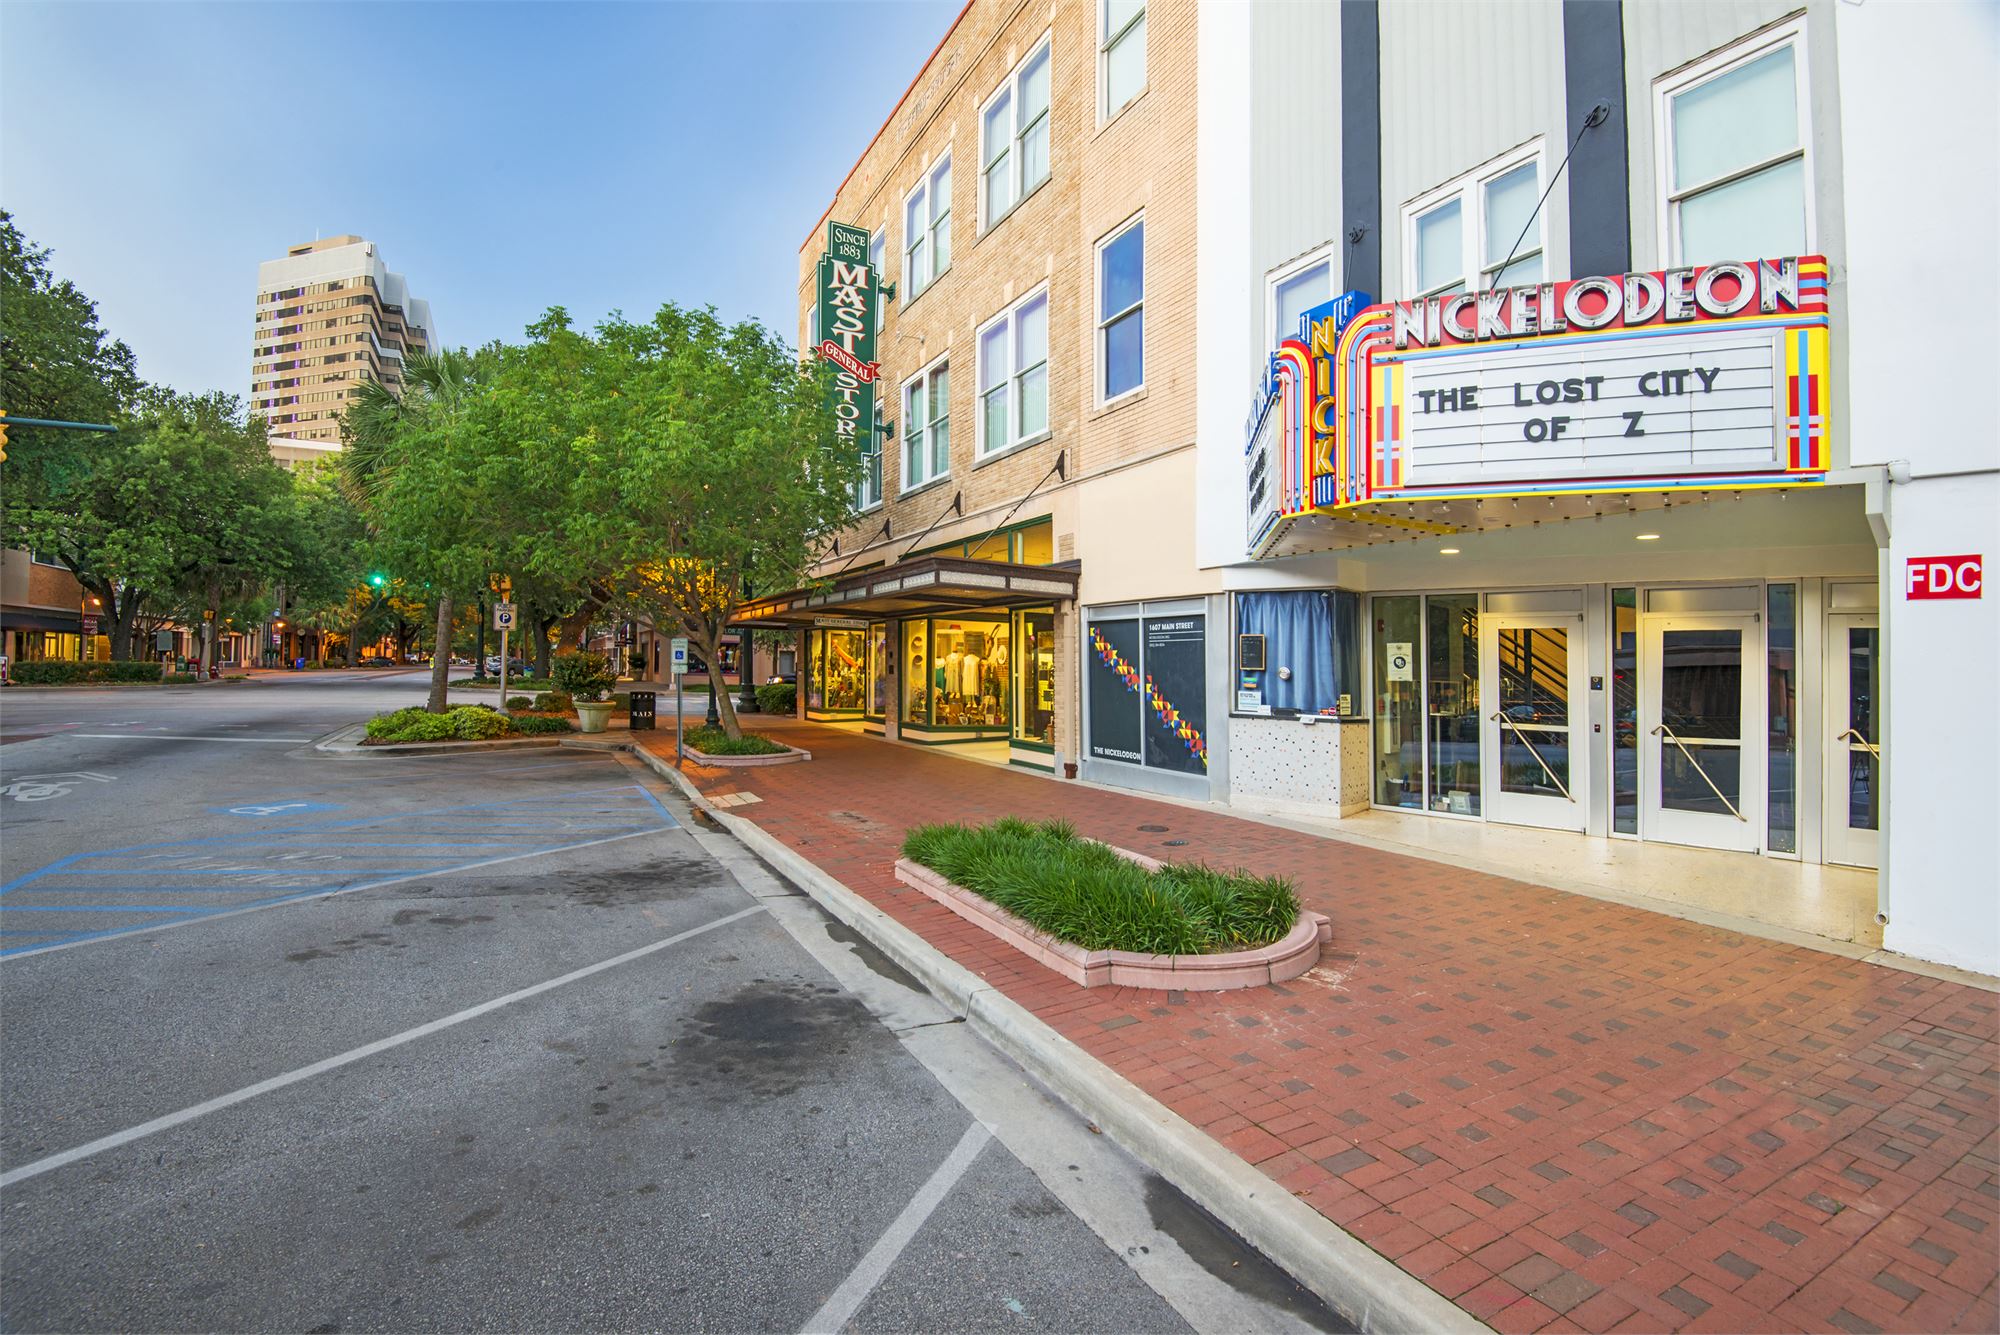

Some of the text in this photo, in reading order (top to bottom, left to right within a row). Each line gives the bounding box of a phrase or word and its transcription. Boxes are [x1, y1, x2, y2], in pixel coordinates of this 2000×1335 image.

[834, 227, 867, 248] SINCE
[839, 243, 861, 260] 1883
[828, 259, 869, 356] MAST
[1395, 256, 1798, 350] NICKELODEON
[825, 342, 871, 381] GENERAL
[1311, 316, 1335, 478] NICK
[1418, 367, 1721, 415] THE LOST CITY
[1524, 411, 1645, 443] OF Z
[1907, 561, 1981, 594] FDC
[1161, 622, 1175, 630] MAIN
[1175, 621, 1194, 630] STREET
[1094, 746, 1142, 760] THE NICKELODEON
